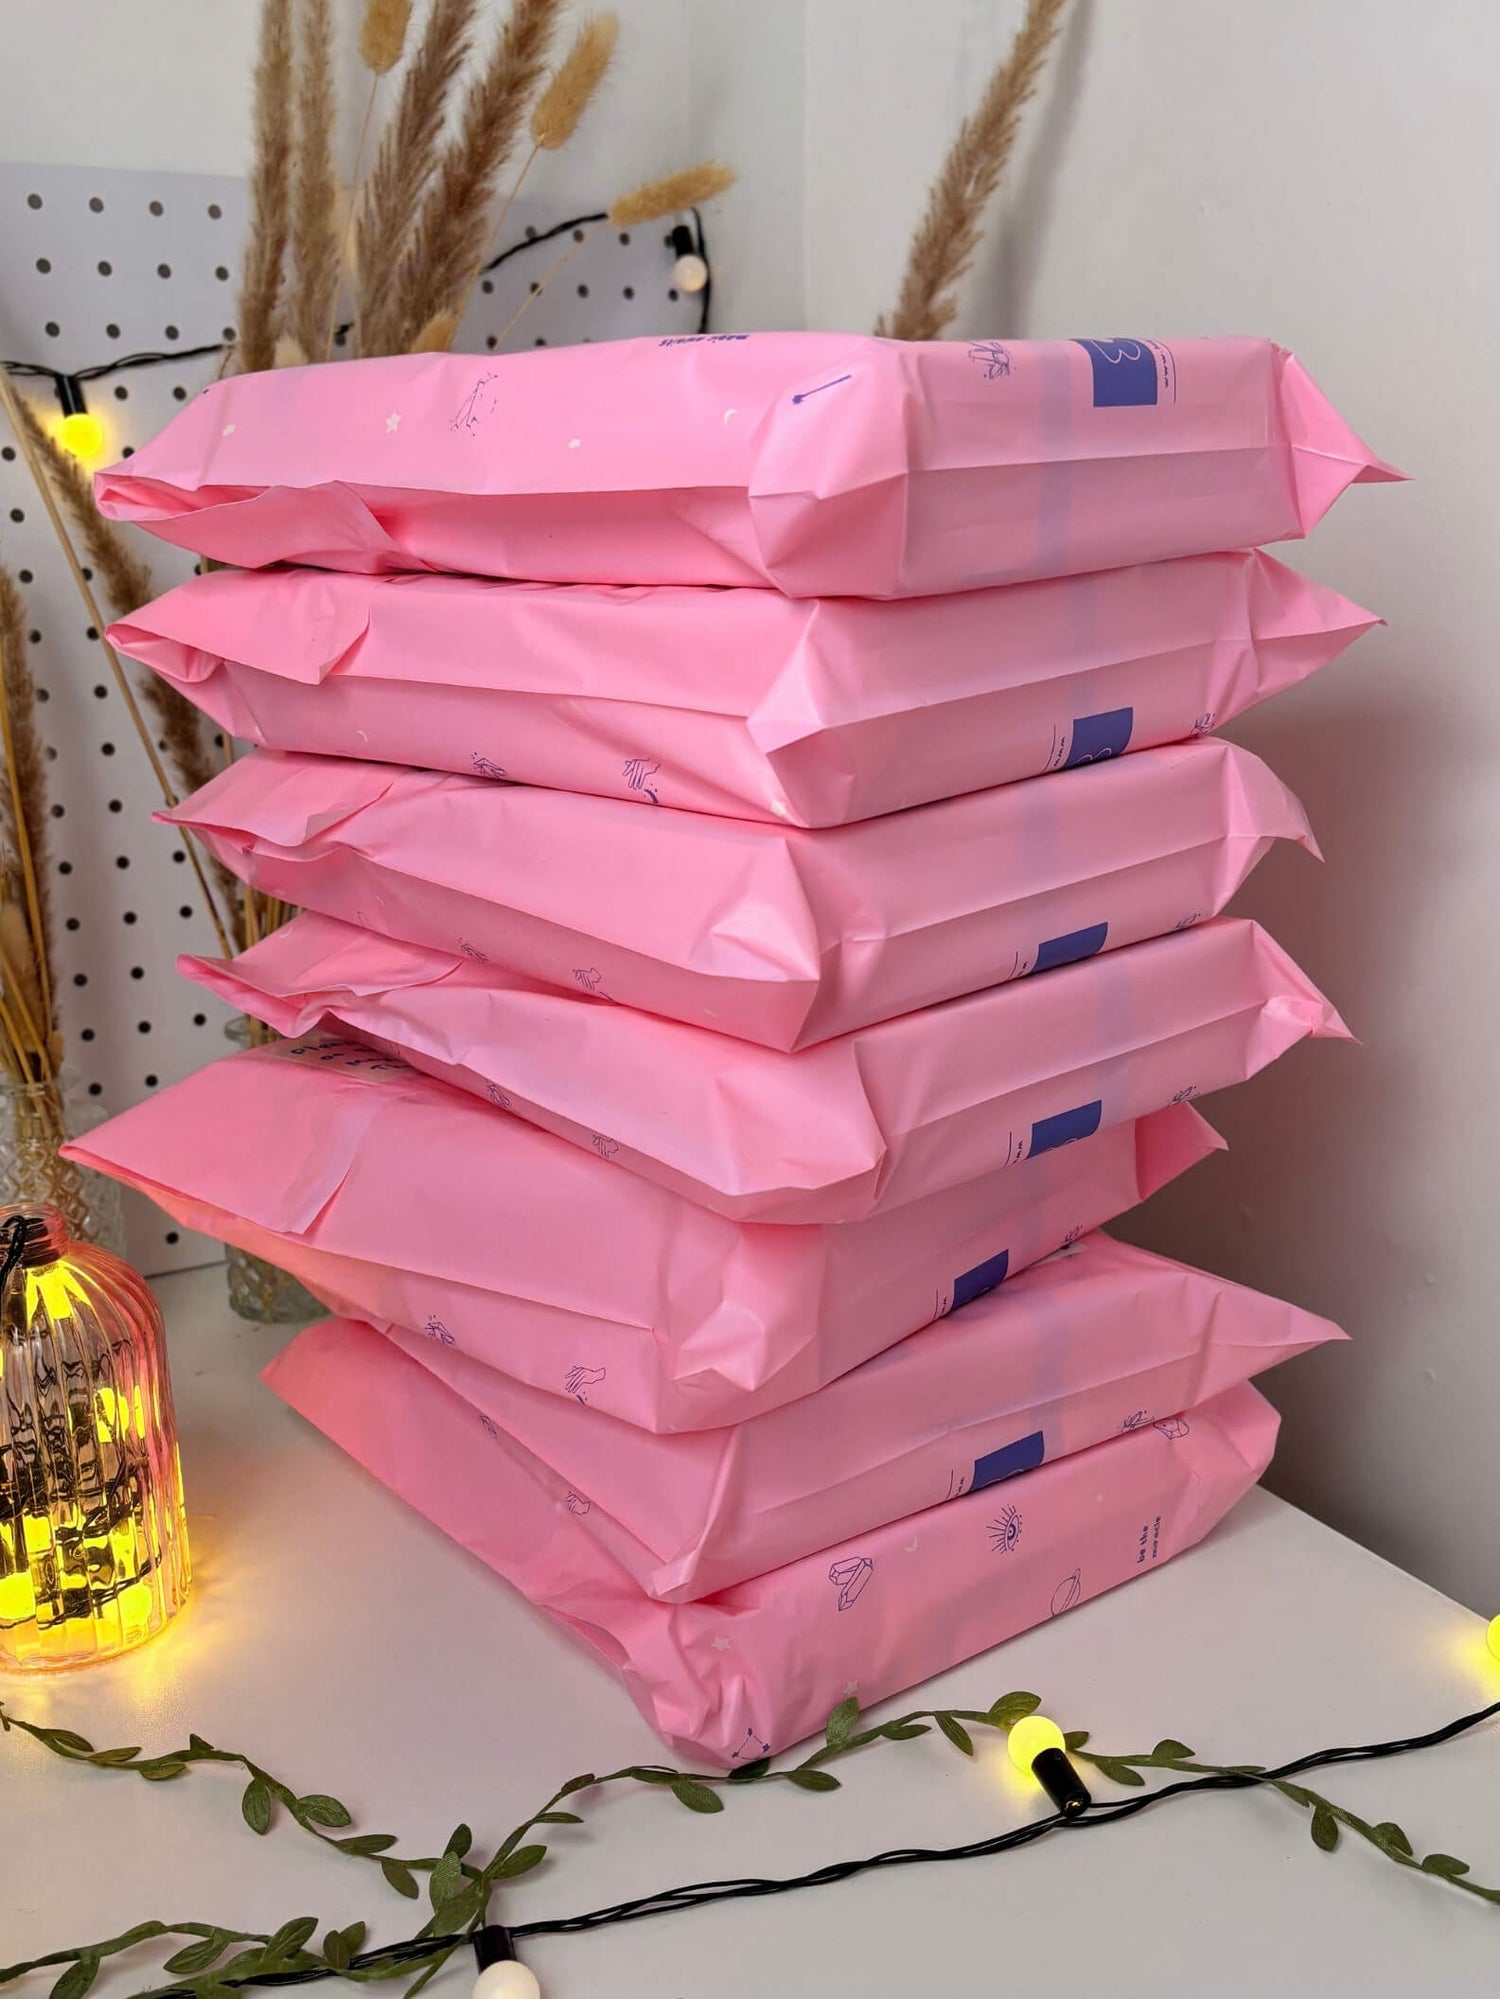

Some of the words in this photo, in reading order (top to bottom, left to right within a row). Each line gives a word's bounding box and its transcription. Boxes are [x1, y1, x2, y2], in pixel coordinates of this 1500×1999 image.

[1139, 1525, 1149, 1546] the
[1152, 1515, 1161, 1558] miracle
[1136, 1548, 1147, 1563] be
